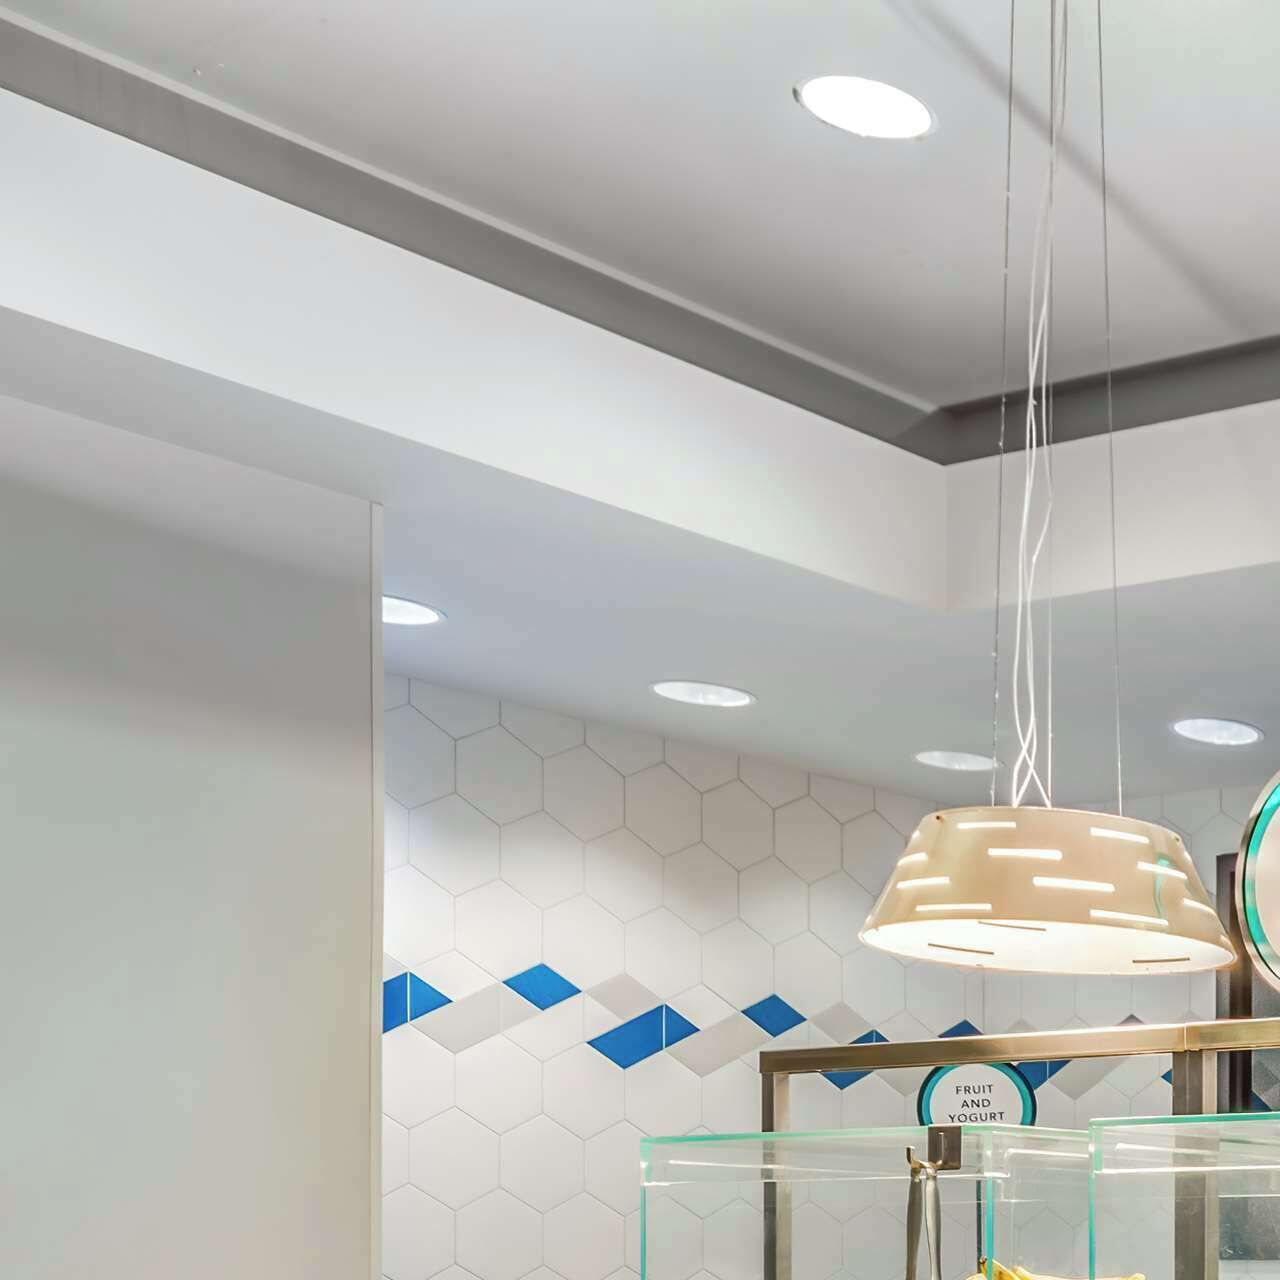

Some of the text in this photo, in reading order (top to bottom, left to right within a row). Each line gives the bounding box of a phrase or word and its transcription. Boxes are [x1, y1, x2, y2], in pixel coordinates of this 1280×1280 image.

[955, 1084, 993, 1095] FRUIT
[961, 1098, 991, 1109] AND
[948, 1111, 1005, 1123] YOGURT
